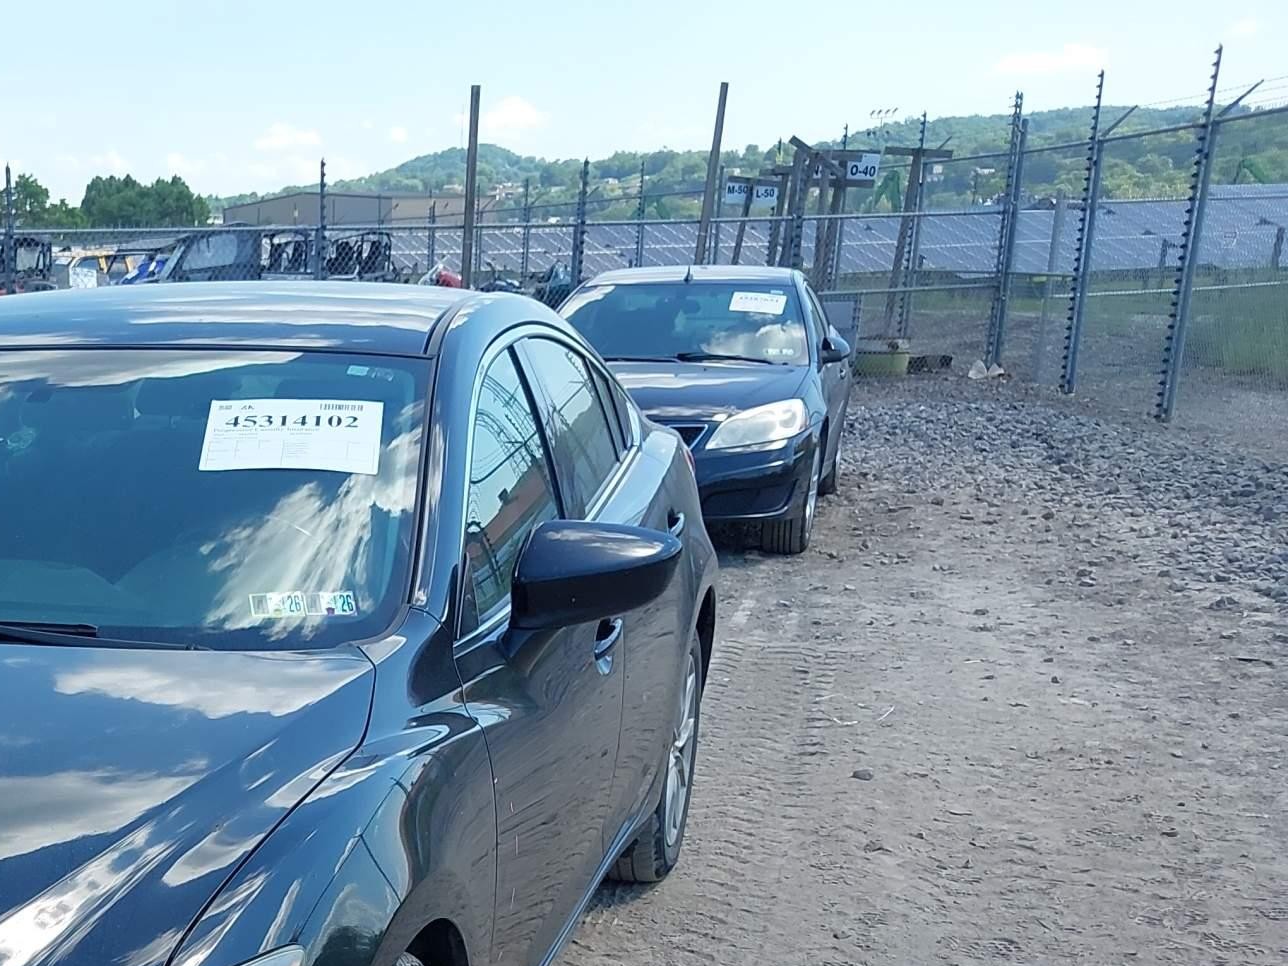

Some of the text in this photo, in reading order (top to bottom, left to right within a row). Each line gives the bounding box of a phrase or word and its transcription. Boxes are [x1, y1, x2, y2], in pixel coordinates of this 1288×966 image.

[850, 165, 876, 177] O-40
[755, 188, 775, 199] L-50
[224, 414, 360, 429] 45314102
[286, 594, 302, 613] 26
[338, 594, 354, 613] 26
